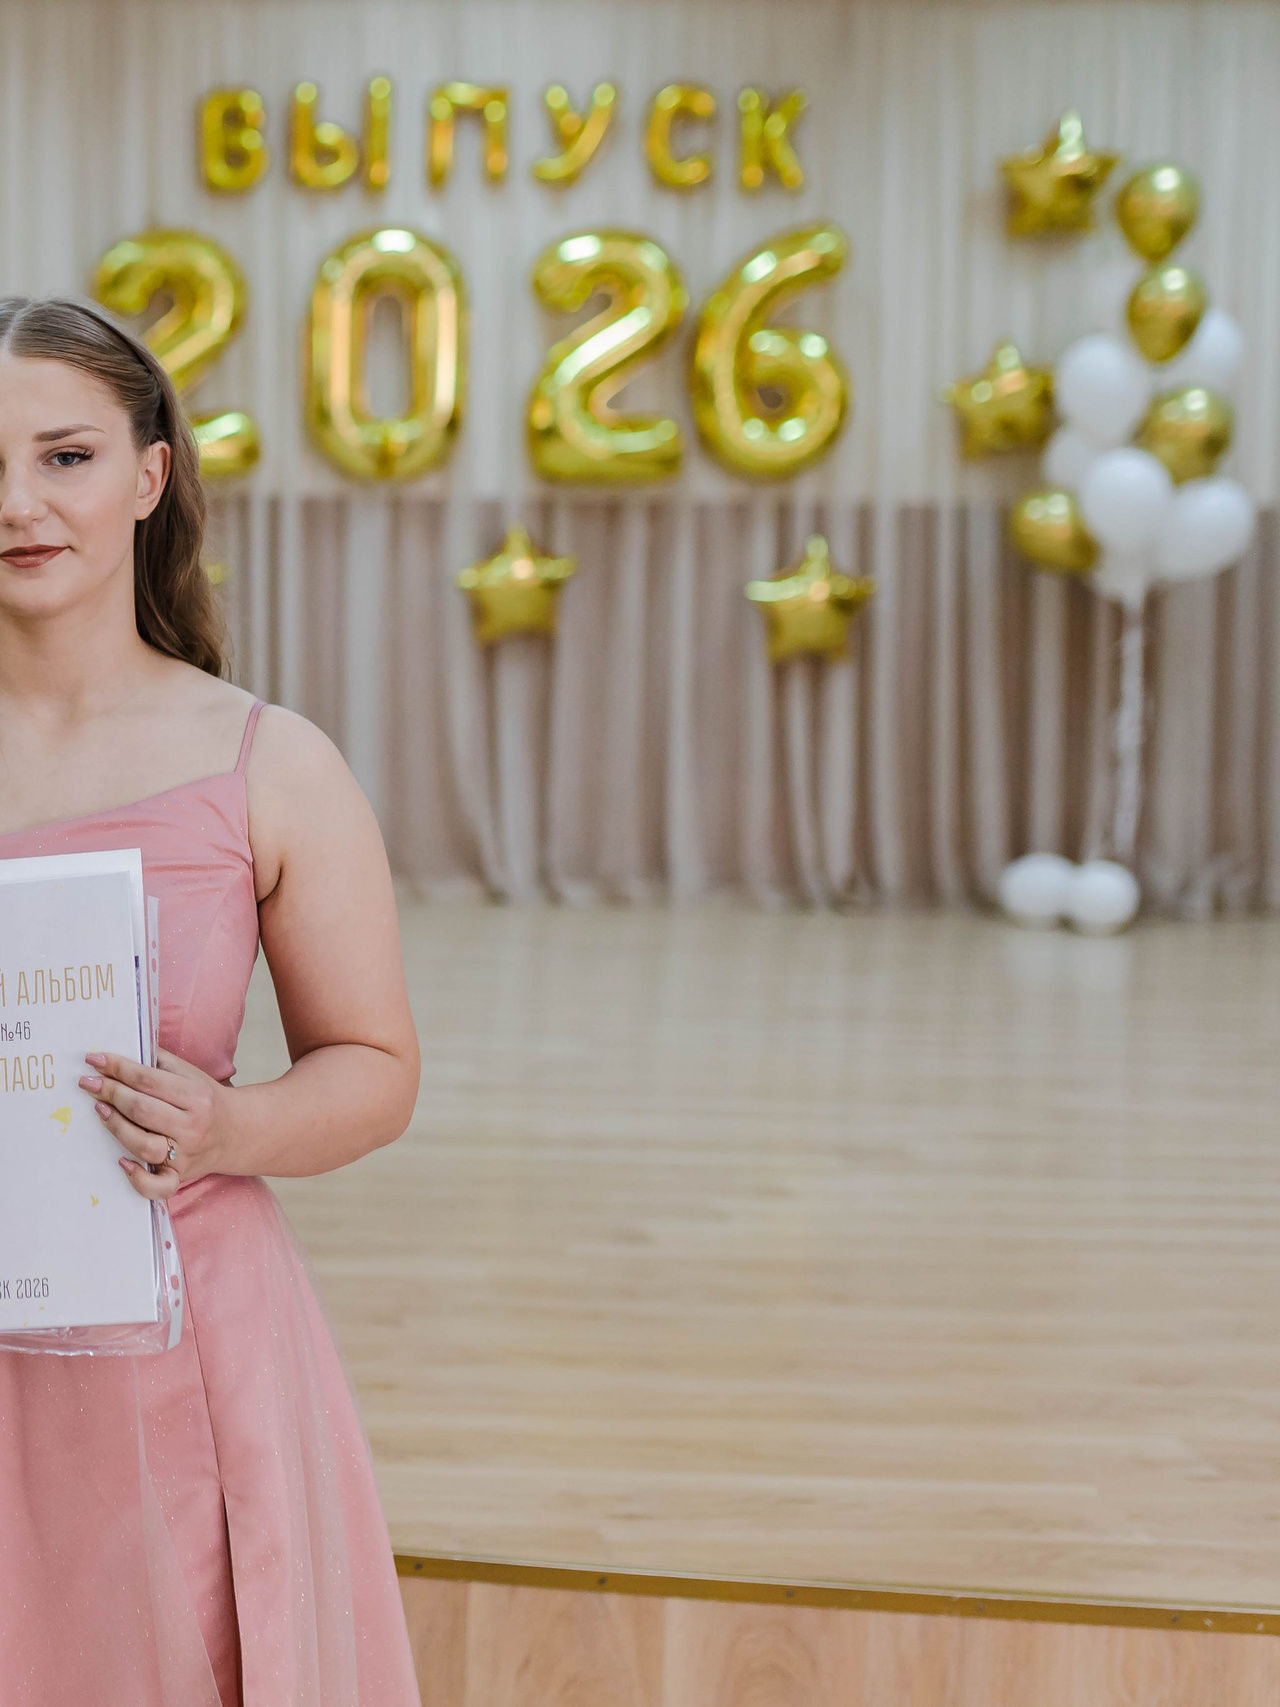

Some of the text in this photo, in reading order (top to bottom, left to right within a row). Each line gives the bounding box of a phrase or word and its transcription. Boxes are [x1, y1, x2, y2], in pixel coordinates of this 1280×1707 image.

[200, 74, 808, 195] ВЫПУСК
[91, 221, 851, 486] 2026
[16, 962, 116, 1007] АЛЬБОМ
[0, 1020, 32, 1043] №46
[15, 1277, 50, 1300] 2026
